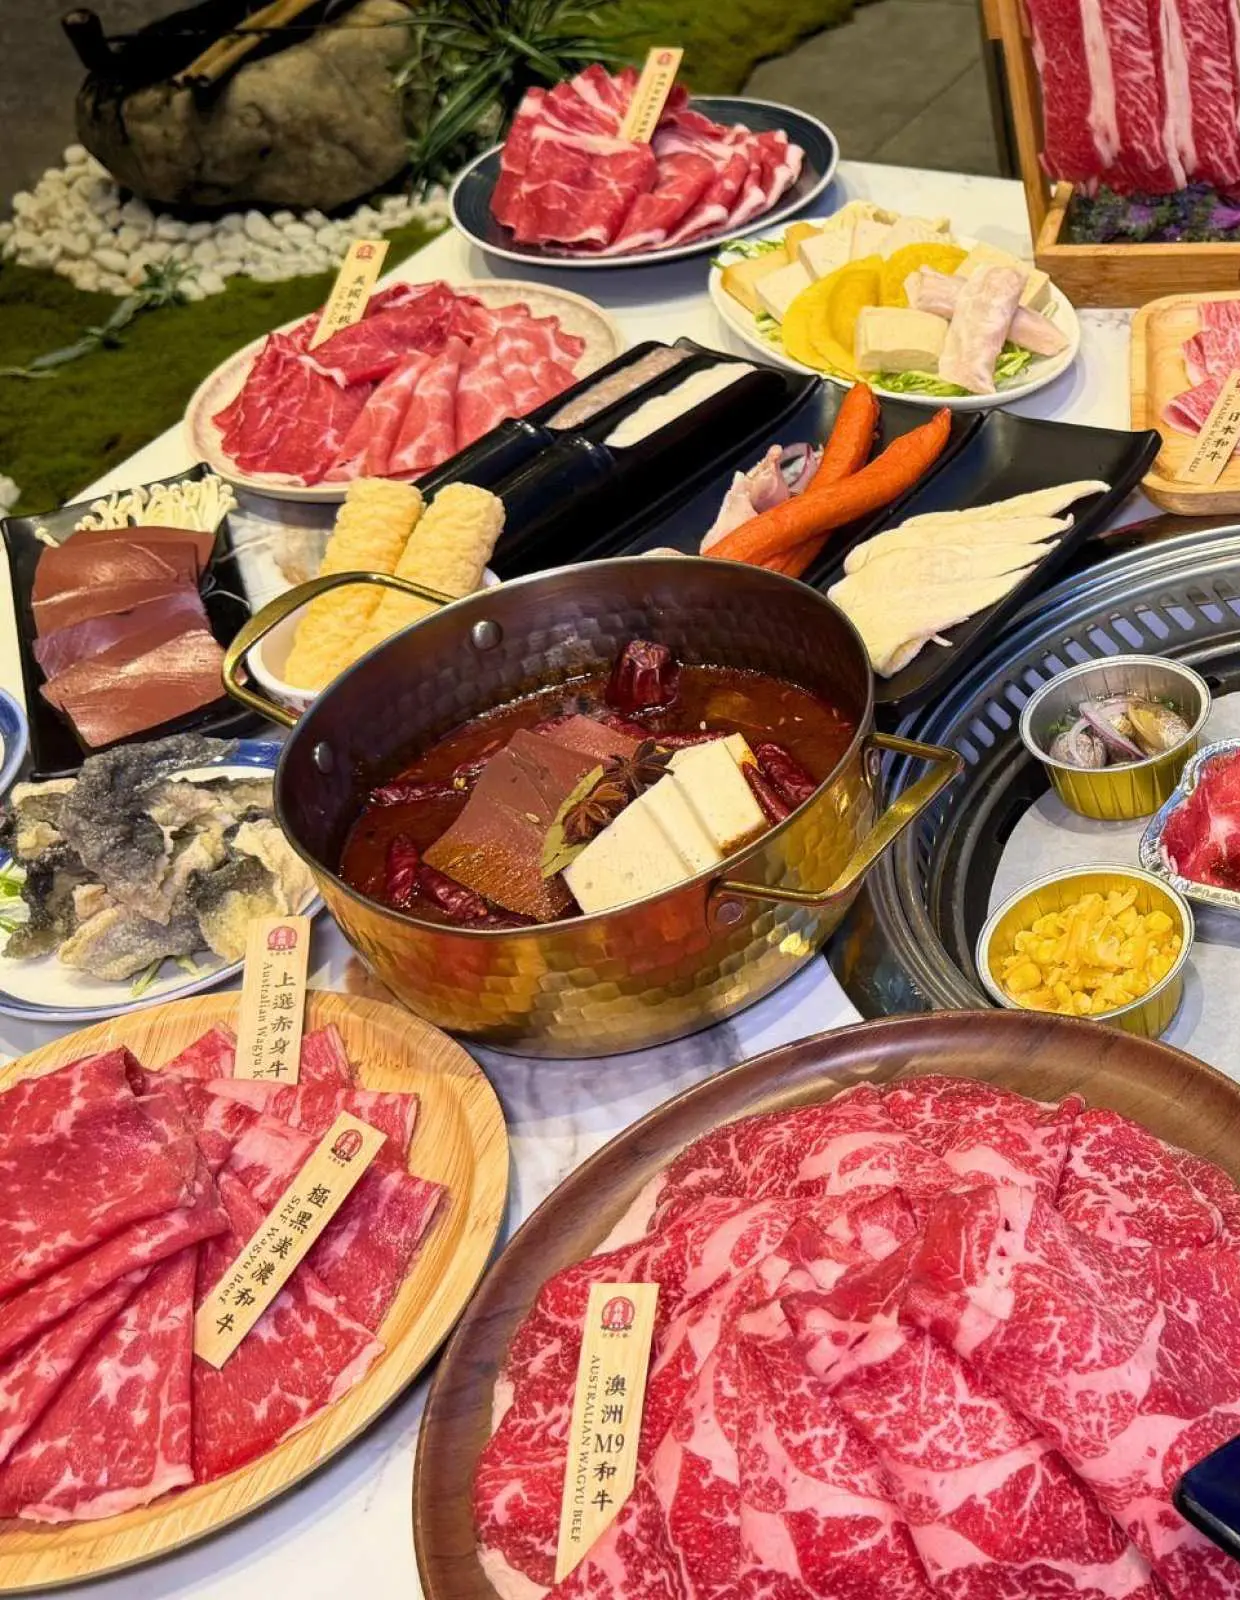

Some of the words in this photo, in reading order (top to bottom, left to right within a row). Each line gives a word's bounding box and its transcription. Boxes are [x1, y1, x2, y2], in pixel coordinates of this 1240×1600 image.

[1205, 411, 1240, 462] 日本和牛
[257, 961, 275, 1024] Australian
[251, 1025, 268, 1067] Wagyu
[266, 970, 296, 1079] 上選赤身牛
[278, 1194, 302, 1226] SRF
[215, 1182, 332, 1336] 極黑美濃和牛
[241, 1226, 280, 1272] Wagyu
[217, 1272, 245, 1307] Beef
[580, 1355, 602, 1448] AUSTRALIAN
[574, 1449, 590, 1505] WAGYU
[569, 1507, 584, 1543] BEEF
